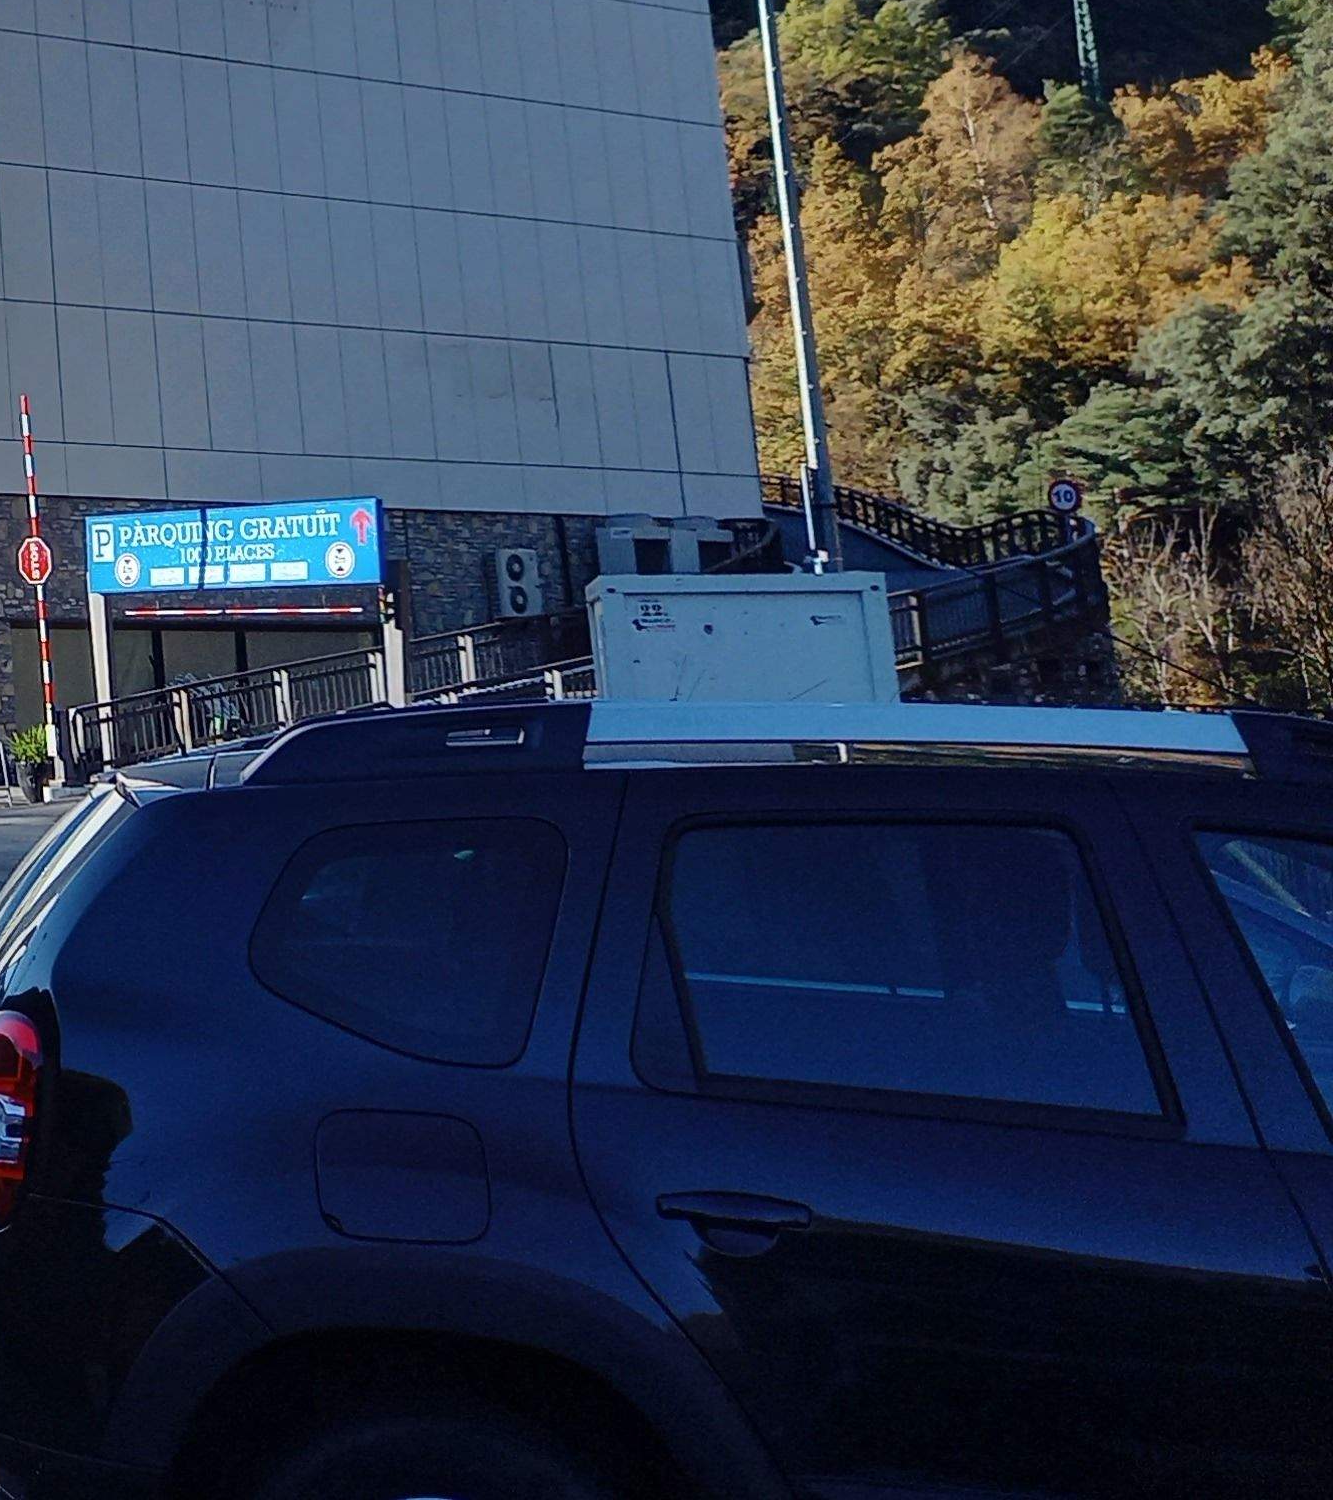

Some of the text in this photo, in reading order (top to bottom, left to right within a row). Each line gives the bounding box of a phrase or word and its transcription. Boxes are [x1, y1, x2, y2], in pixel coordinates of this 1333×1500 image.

[1054, 490, 1074, 503] 10
[95, 528, 111, 558] P
[118, 518, 235, 548] PÀRQUING
[29, 542, 41, 580] STOP
[214, 543, 275, 562] PLACES
